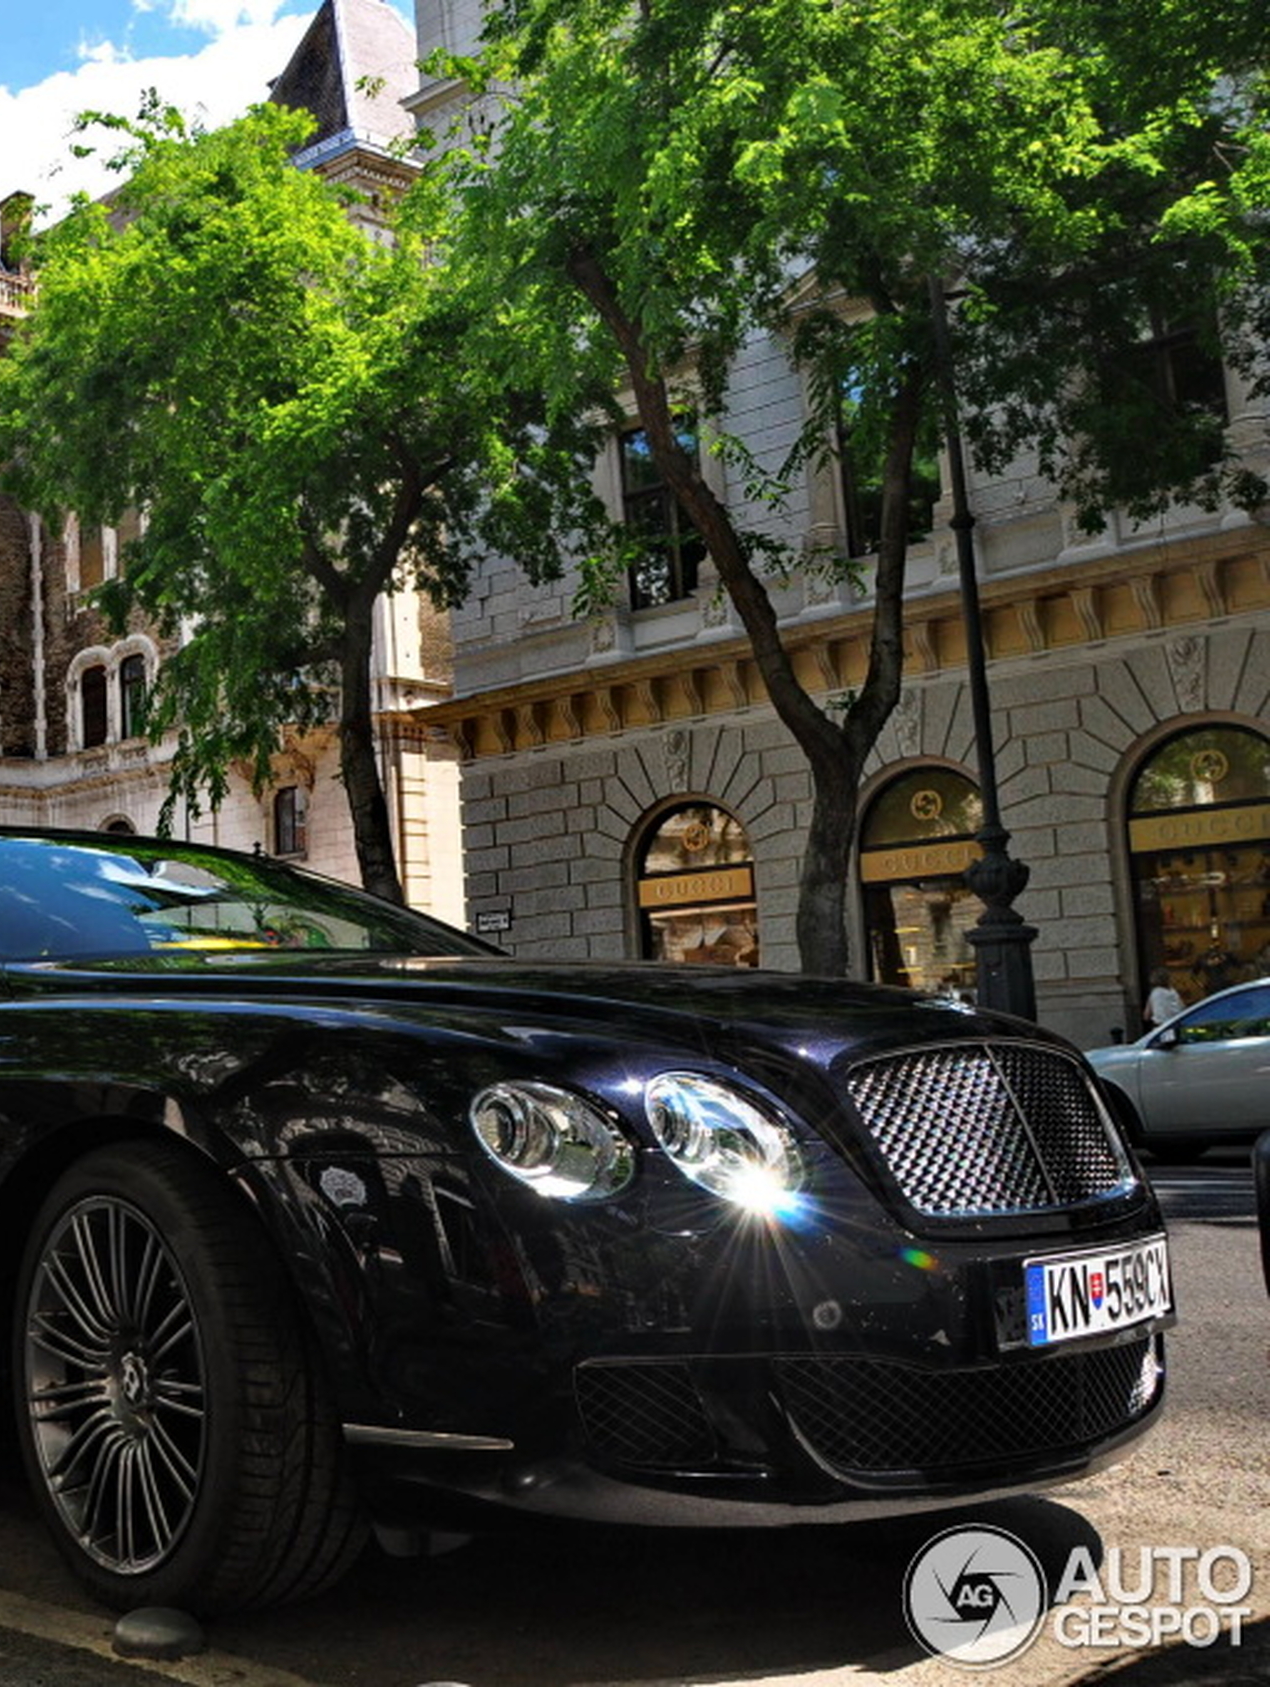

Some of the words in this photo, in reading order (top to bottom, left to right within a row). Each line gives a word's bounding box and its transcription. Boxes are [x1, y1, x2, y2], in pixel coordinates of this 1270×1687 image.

[883, 847, 970, 873] GUCCI
[656, 876, 733, 899] GUCCI
[1048, 1264, 1090, 1335] KN
[1104, 1247, 1167, 1323] 559CX
[1031, 1313, 1045, 1331] SK
